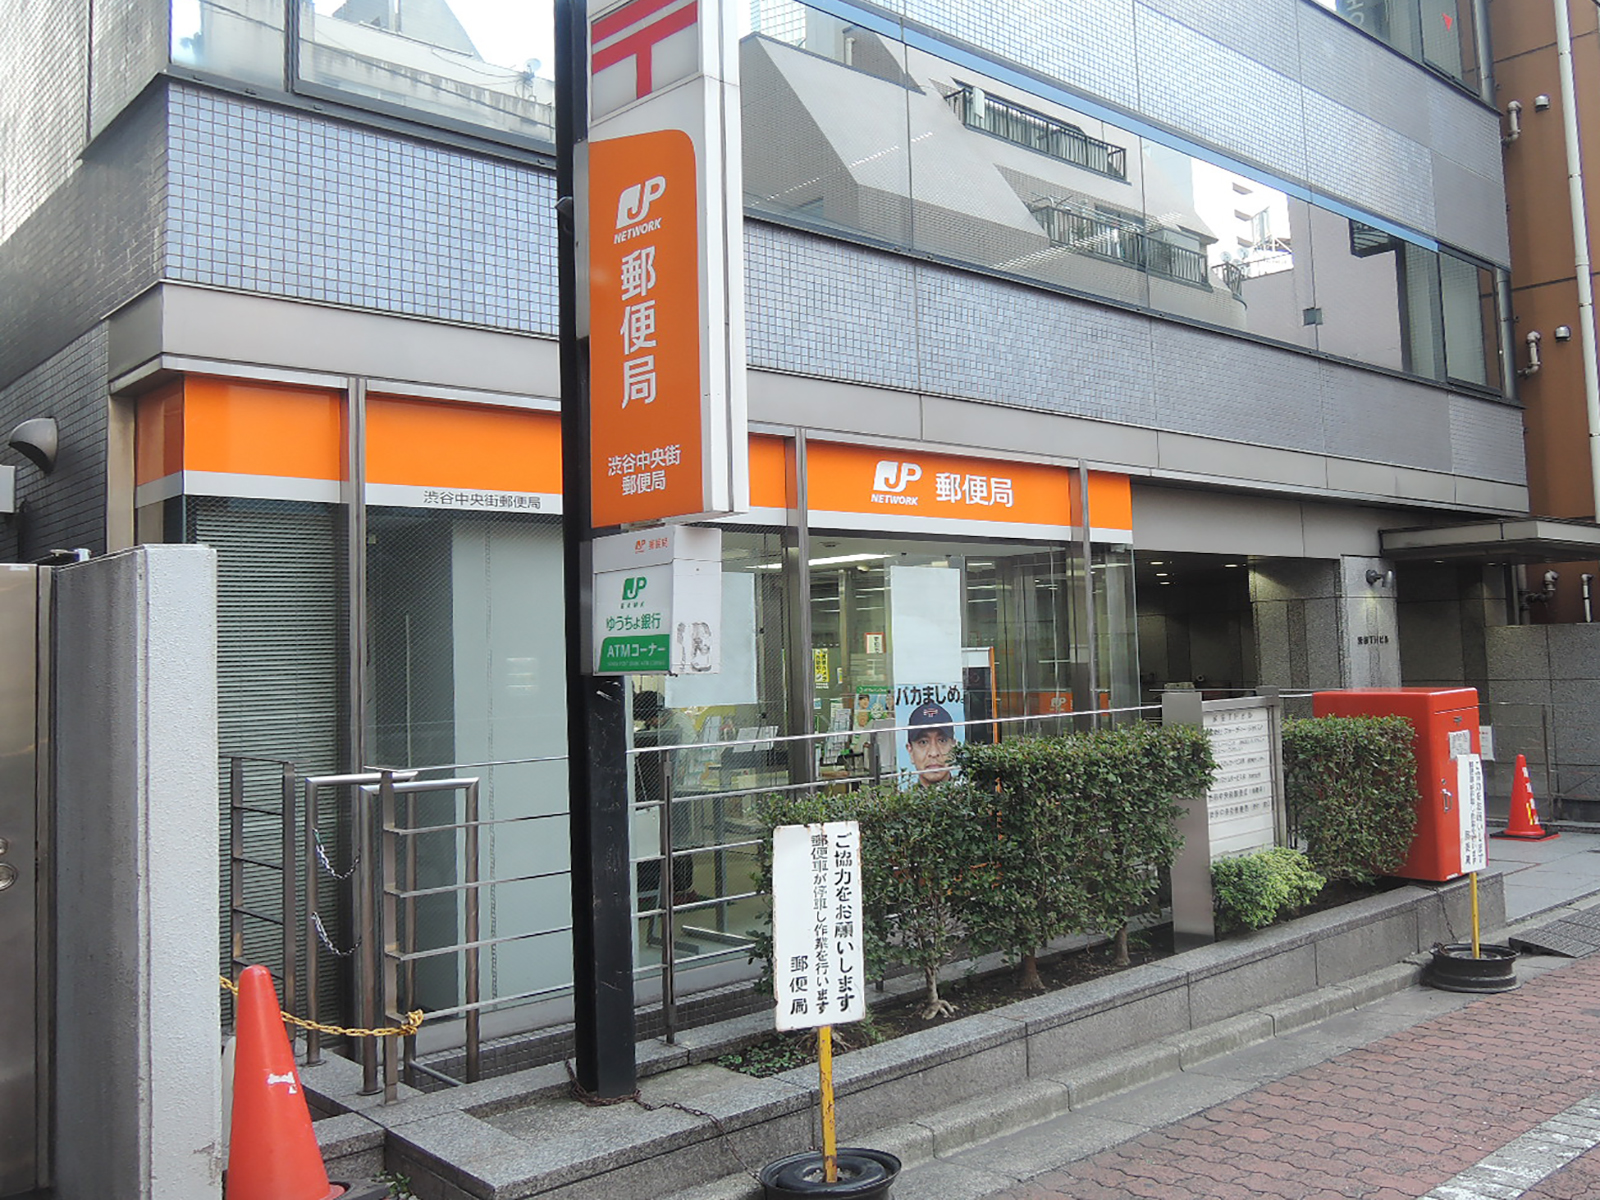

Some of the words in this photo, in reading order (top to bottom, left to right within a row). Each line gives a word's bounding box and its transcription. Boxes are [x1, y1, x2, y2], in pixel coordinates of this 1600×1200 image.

[616, 175, 667, 229] JP
[613, 218, 662, 244] NETWORK
[620, 245, 657, 410] 郵便局
[607, 444, 681, 476] 渋谷中央街
[621, 470, 666, 496] 郵便局
[935, 472, 1014, 507] 郵便局
[423, 490, 541, 509] 渋谷中央街郵便局
[871, 493, 918, 506] NETWORK
[622, 576, 647, 600] JP
[606, 613, 661, 631] ゆうちょ銀行
[607, 643, 666, 658] ATMコーナー
[810, 834, 829, 1015] 郵便車が停車し作業を行います
[834, 832, 854, 1013] ご協力をお願いします
[789, 954, 809, 1015] 郵便局
